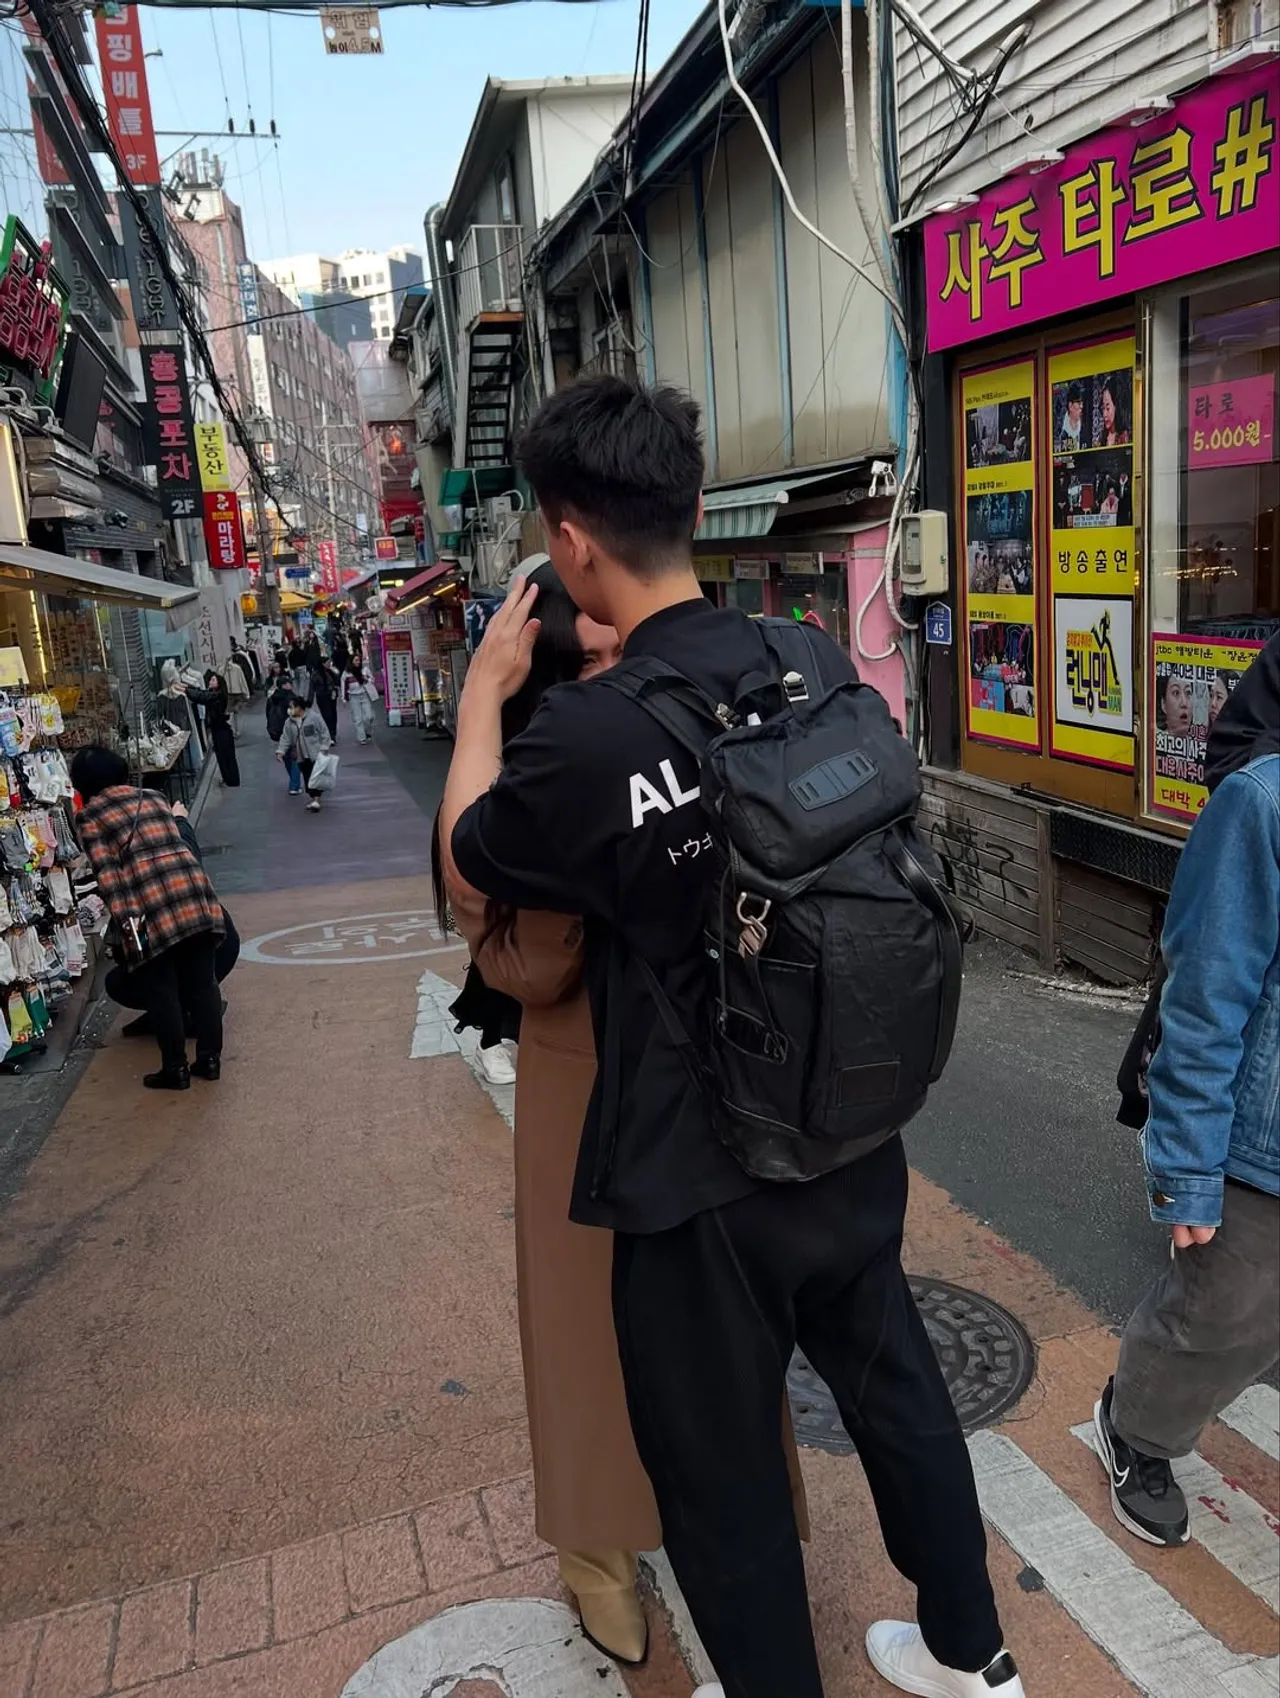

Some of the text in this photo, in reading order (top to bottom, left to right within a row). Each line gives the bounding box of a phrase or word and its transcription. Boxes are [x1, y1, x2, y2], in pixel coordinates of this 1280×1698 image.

[125, 154, 147, 170] 3F
[939, 196, 1046, 321] 사주
[1058, 122, 1204, 280] 타로
[1193, 419, 1261, 452] 5.000원
[200, 427, 224, 476] 부동산
[171, 499, 195, 515] 2F
[1058, 549, 1128, 574] 방송출연
[932, 622, 945, 638] 45
[1066, 649, 1108, 714] 런닝맨
[1161, 789, 1191, 810] 대박
